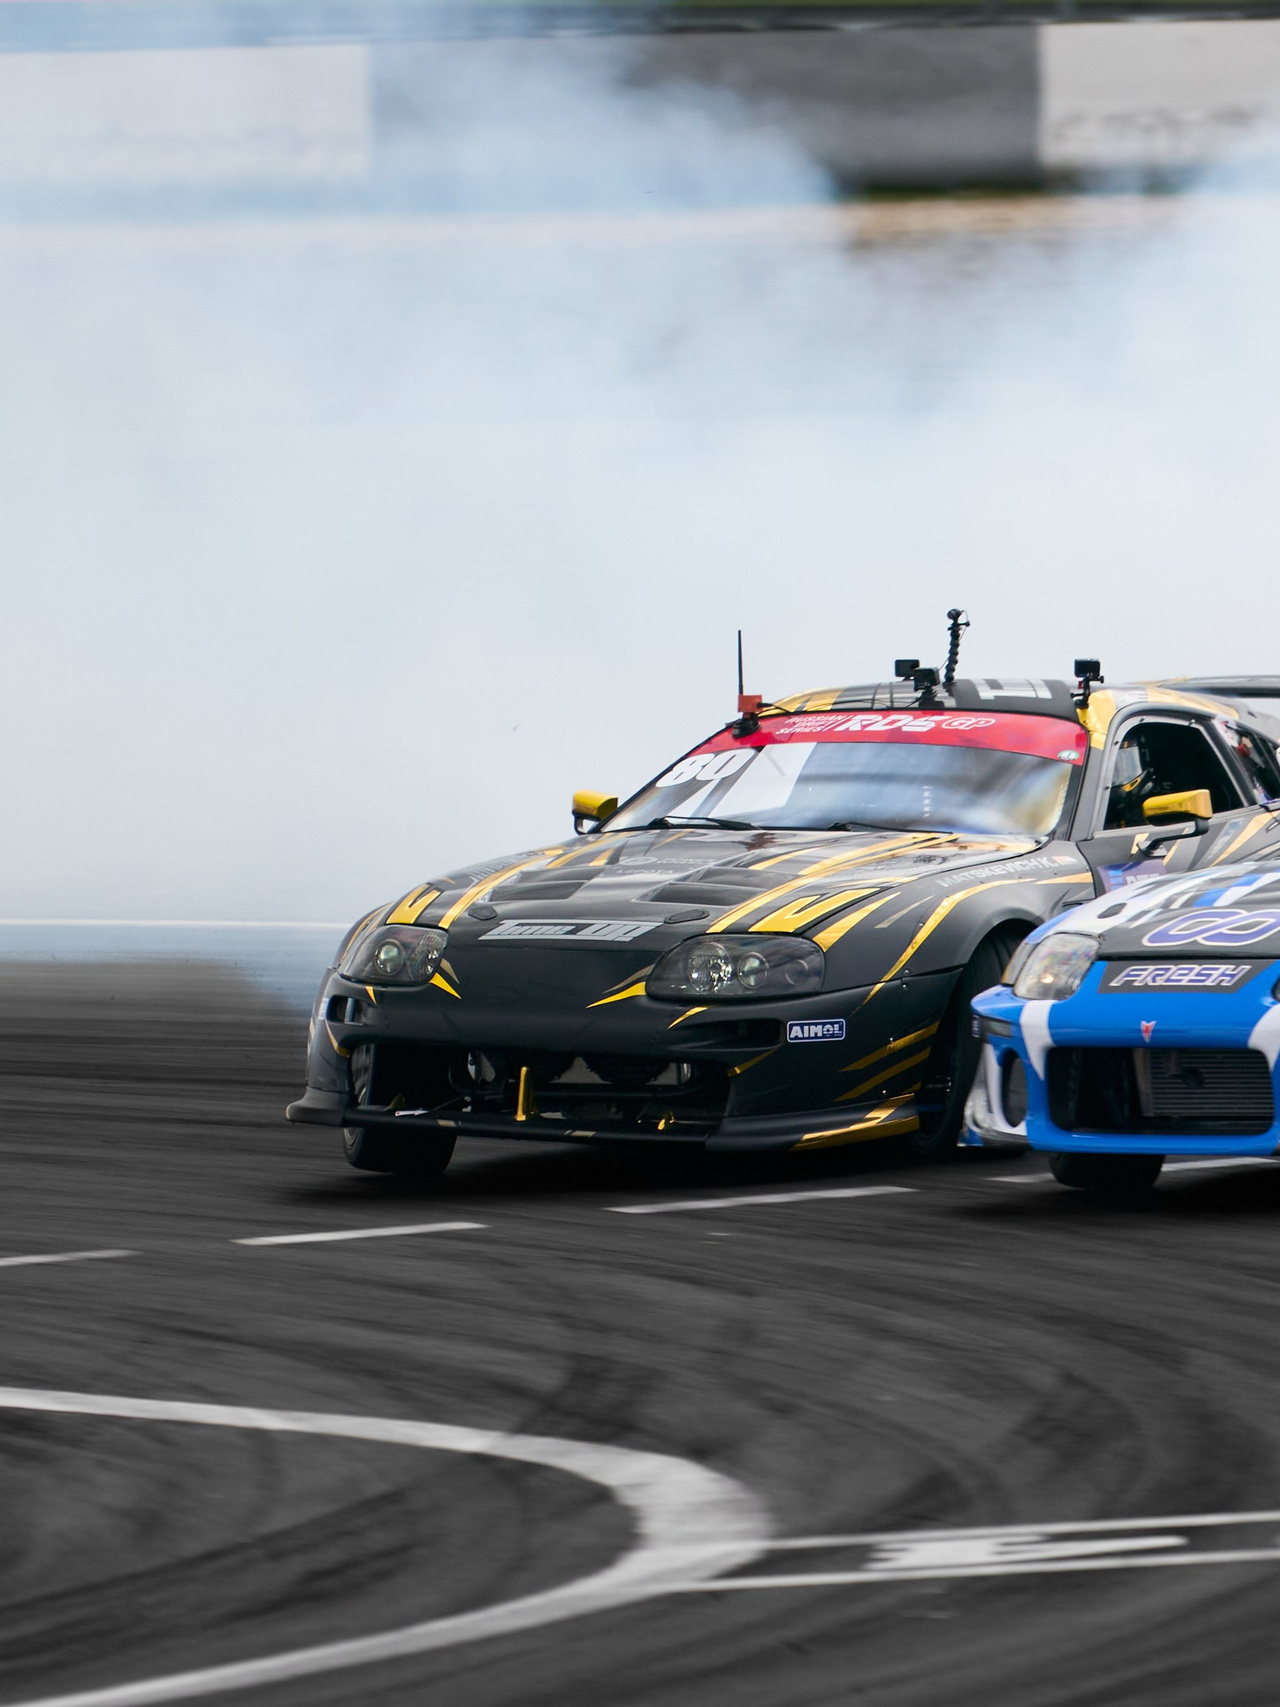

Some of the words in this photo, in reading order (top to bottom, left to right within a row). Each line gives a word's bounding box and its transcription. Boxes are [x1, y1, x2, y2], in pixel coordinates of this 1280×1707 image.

[833, 713, 950, 732] RDS
[941, 715, 996, 731] GP
[655, 748, 761, 789] 80
[936, 858, 1038, 888] MATSKEVICH
[789, 1024, 843, 1039] AIMOL
